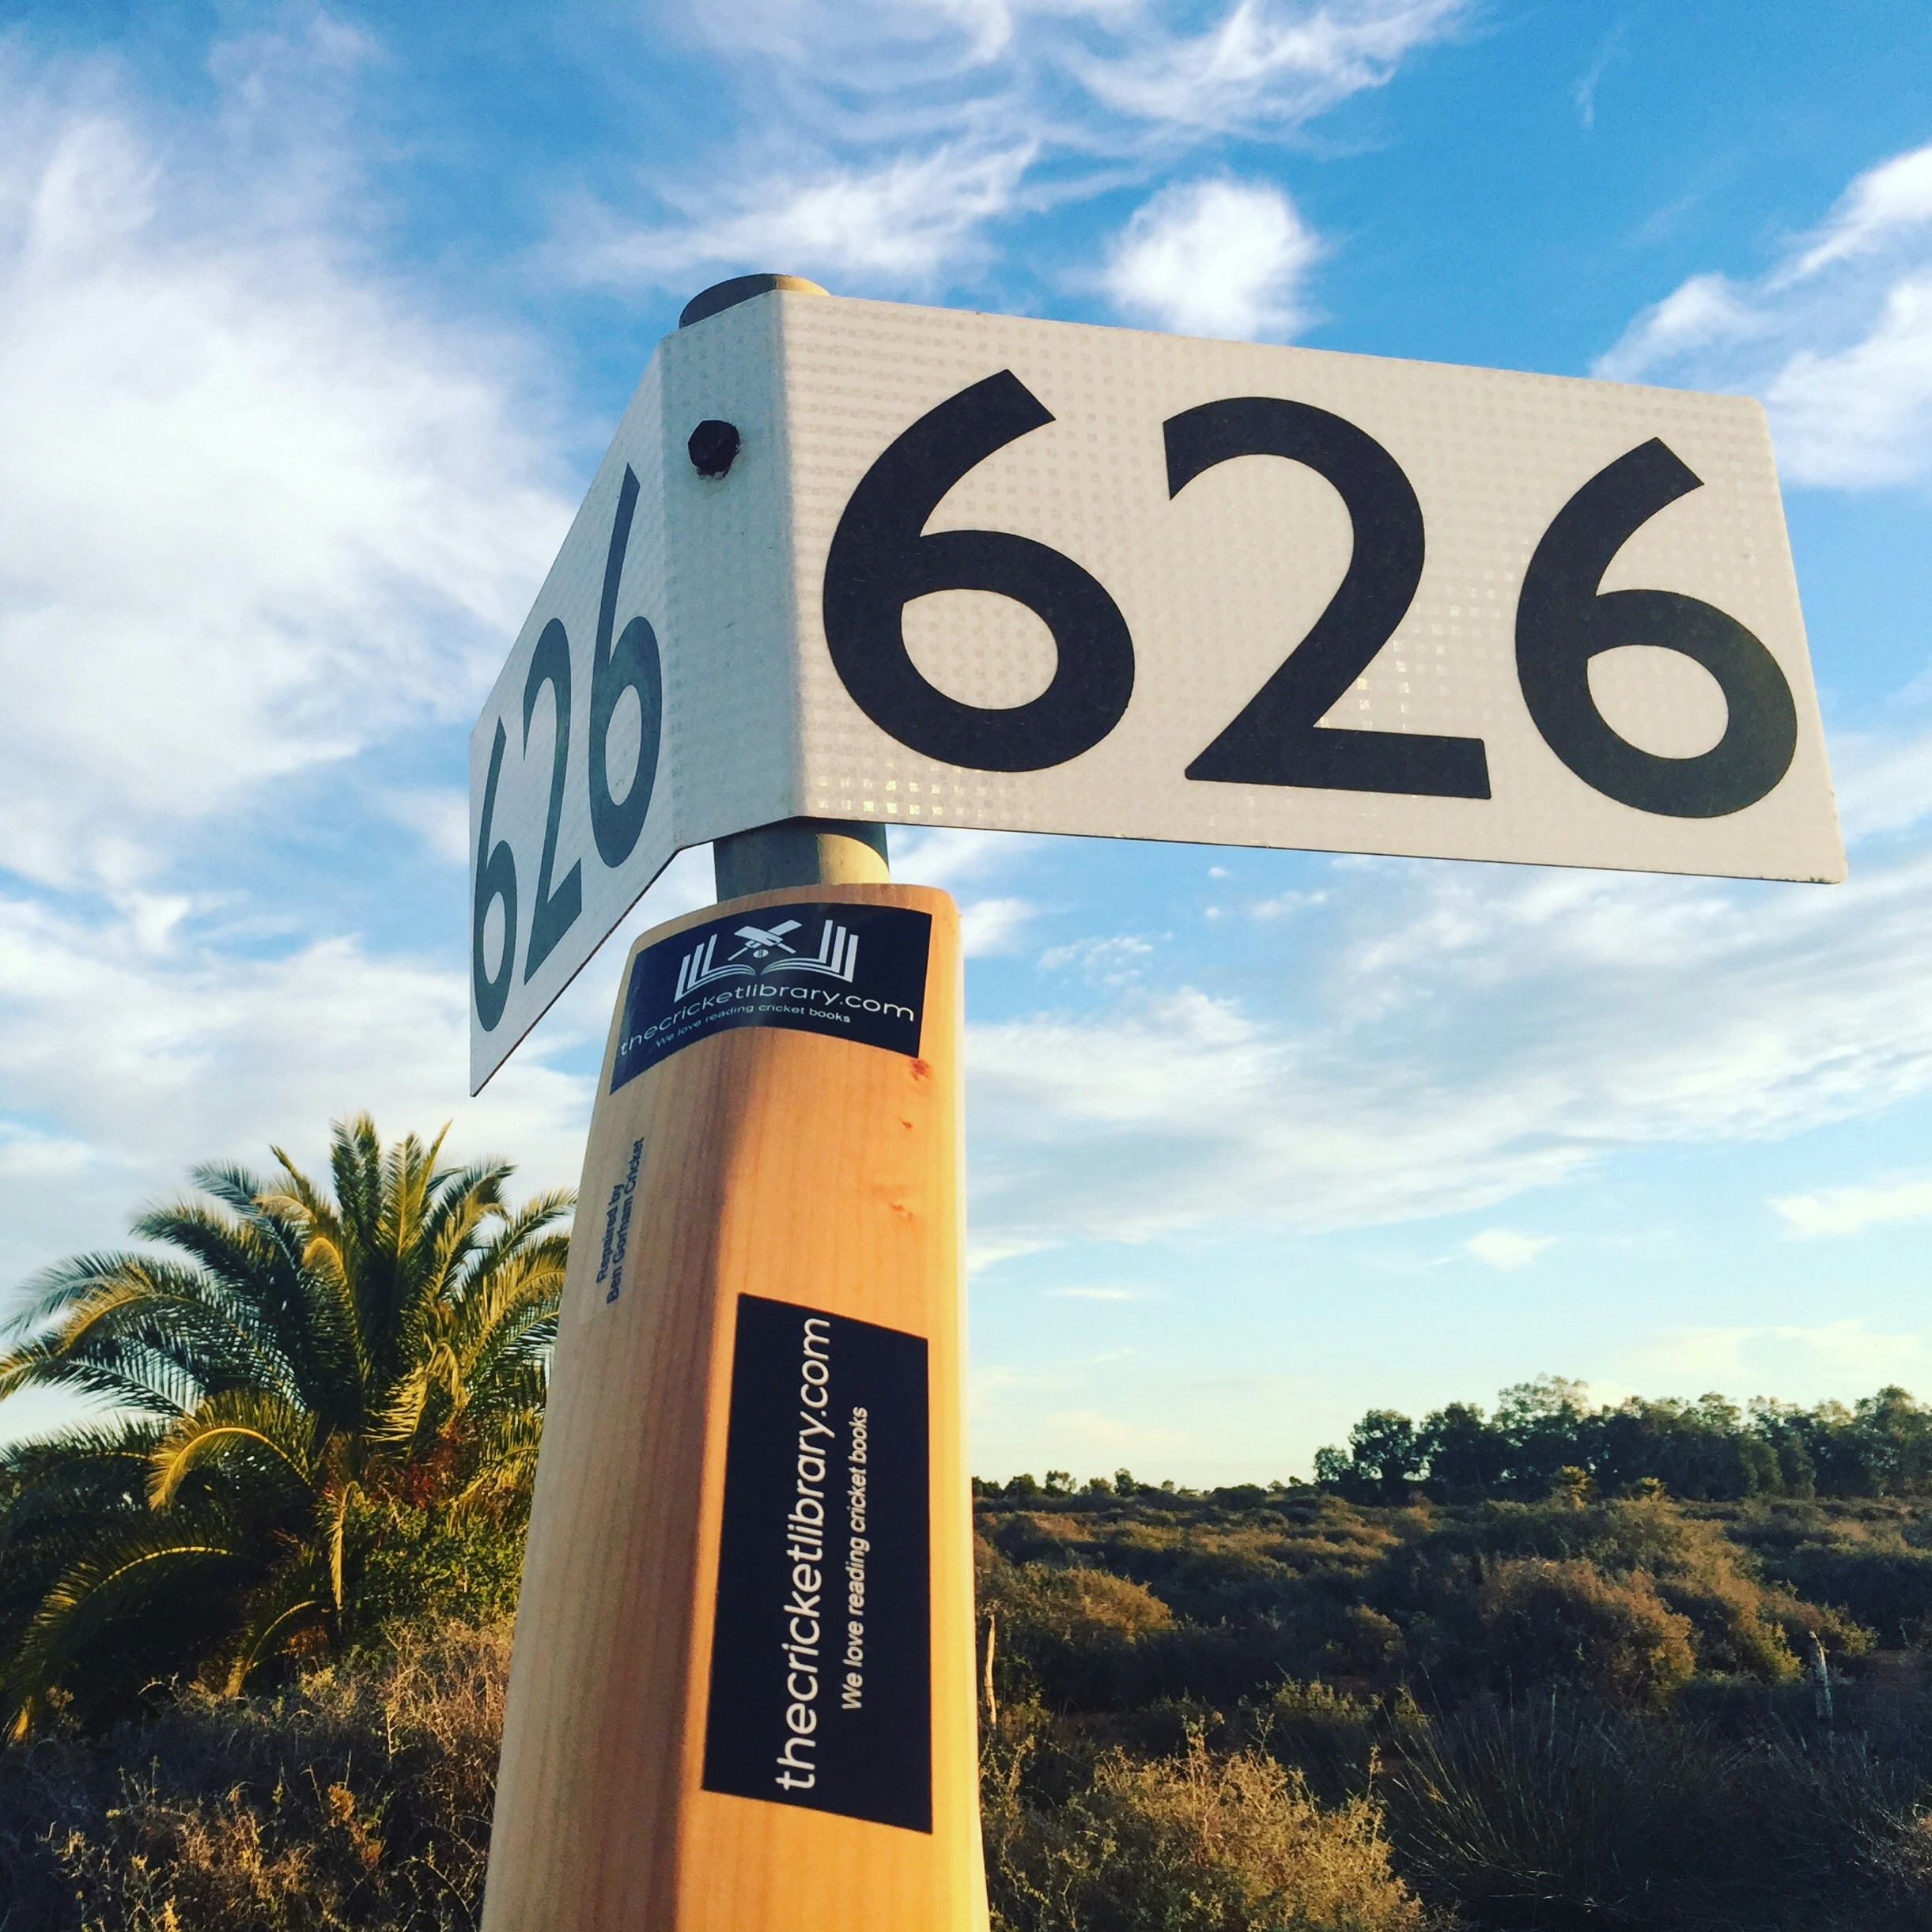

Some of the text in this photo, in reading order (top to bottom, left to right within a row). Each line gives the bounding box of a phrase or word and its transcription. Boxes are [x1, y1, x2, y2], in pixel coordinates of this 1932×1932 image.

[822, 369, 1797, 819] 626
[473, 463, 663, 1033] 626
[620, 984, 914, 1056] thecricketlibrary.com
[656, 1004, 851, 1049] We love reading cricket books
[606, 1265, 623, 1304] Ben
[607, 1184, 625, 1206] by
[776, 1318, 835, 1790] thecricketlibrary.com
[841, 1407, 870, 1711] We love reading cricket books
